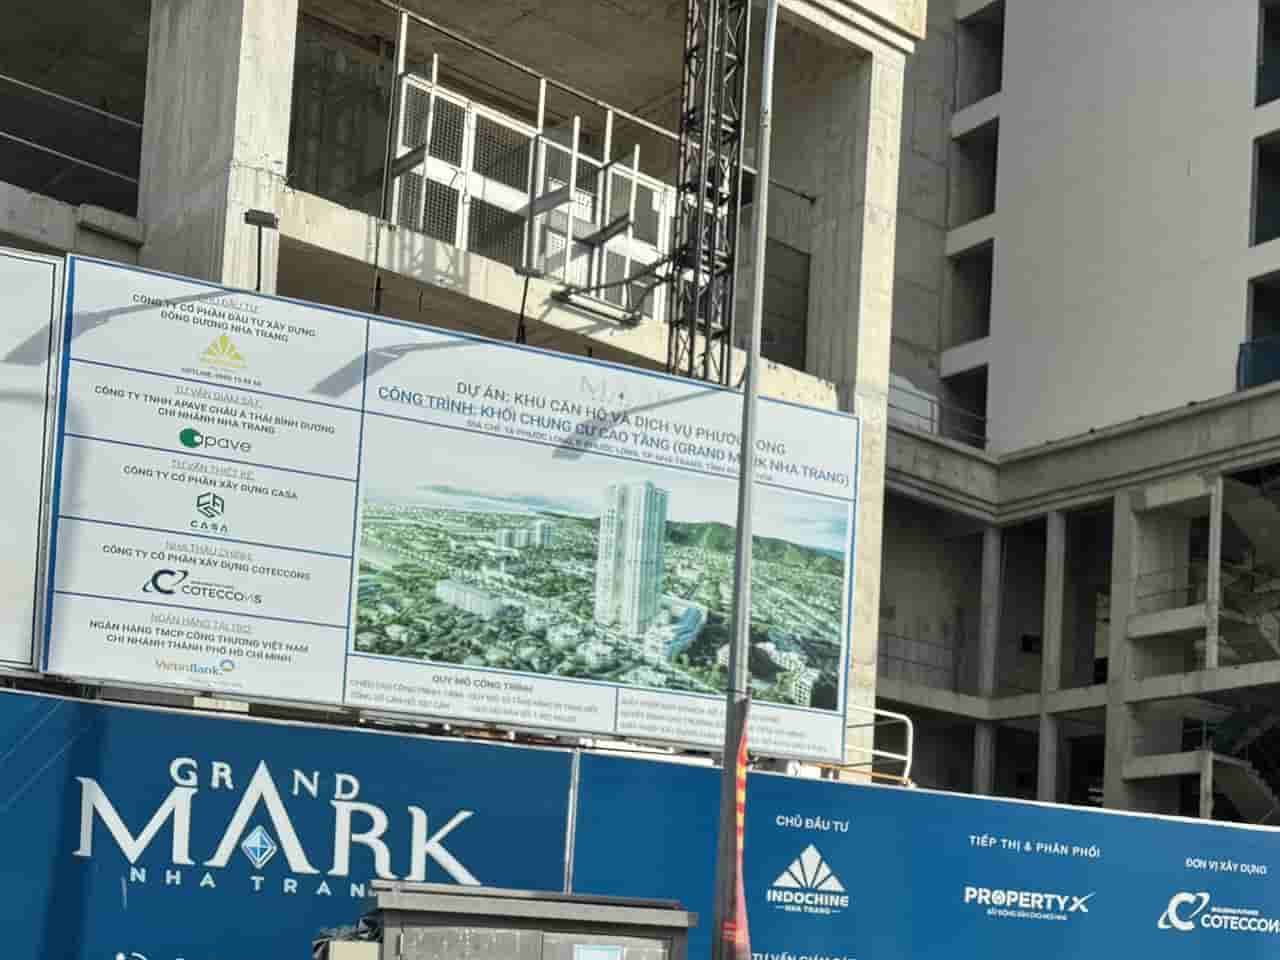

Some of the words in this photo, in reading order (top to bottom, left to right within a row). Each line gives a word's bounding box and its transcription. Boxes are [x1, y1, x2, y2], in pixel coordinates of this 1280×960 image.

[520, 413, 573, 432] CHUNG
[769, 461, 799, 477] NHA
[754, 438, 787, 455] ONG
[72, 760, 482, 886] MARK
[250, 875, 377, 898] TRAN
[766, 888, 849, 908] INDOCHINE
